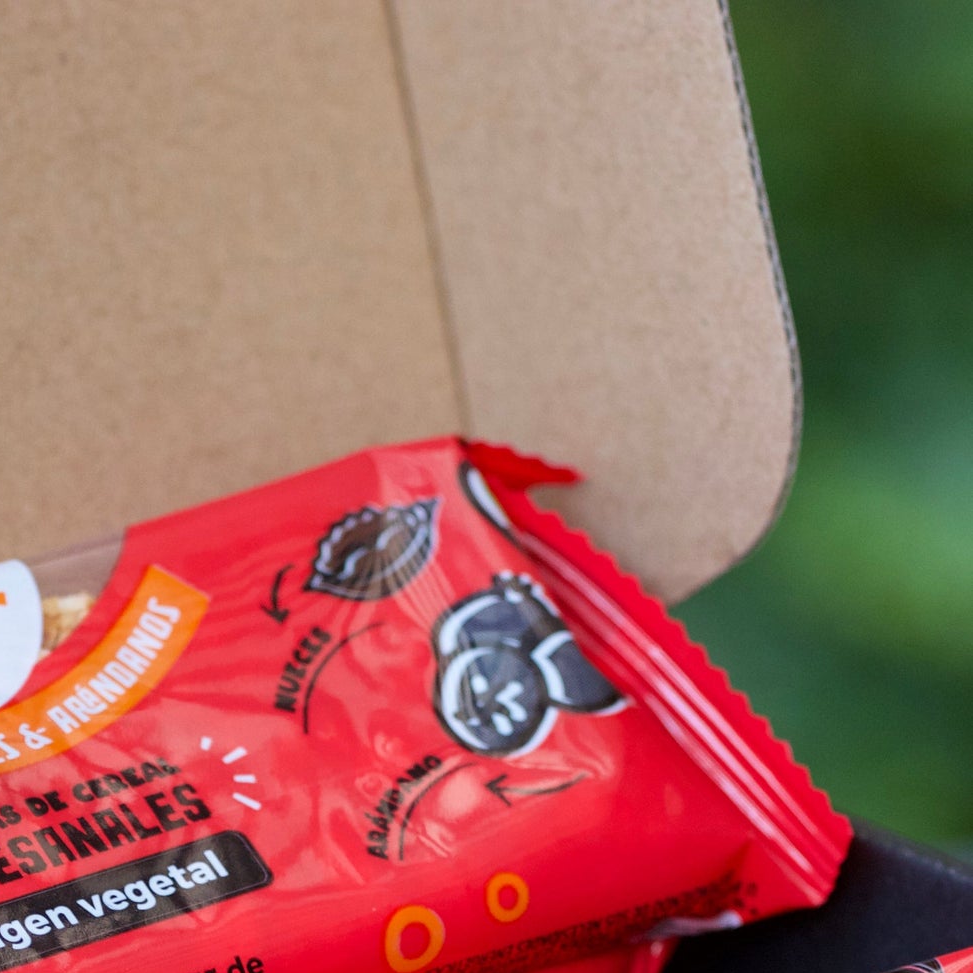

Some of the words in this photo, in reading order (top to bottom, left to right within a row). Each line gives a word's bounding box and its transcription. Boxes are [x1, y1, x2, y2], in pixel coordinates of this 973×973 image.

[19, 724, 53, 751] &
[24, 789, 68, 818] DE
[71, 757, 184, 804] CEREAL
[76, 849, 230, 919] vegetal
